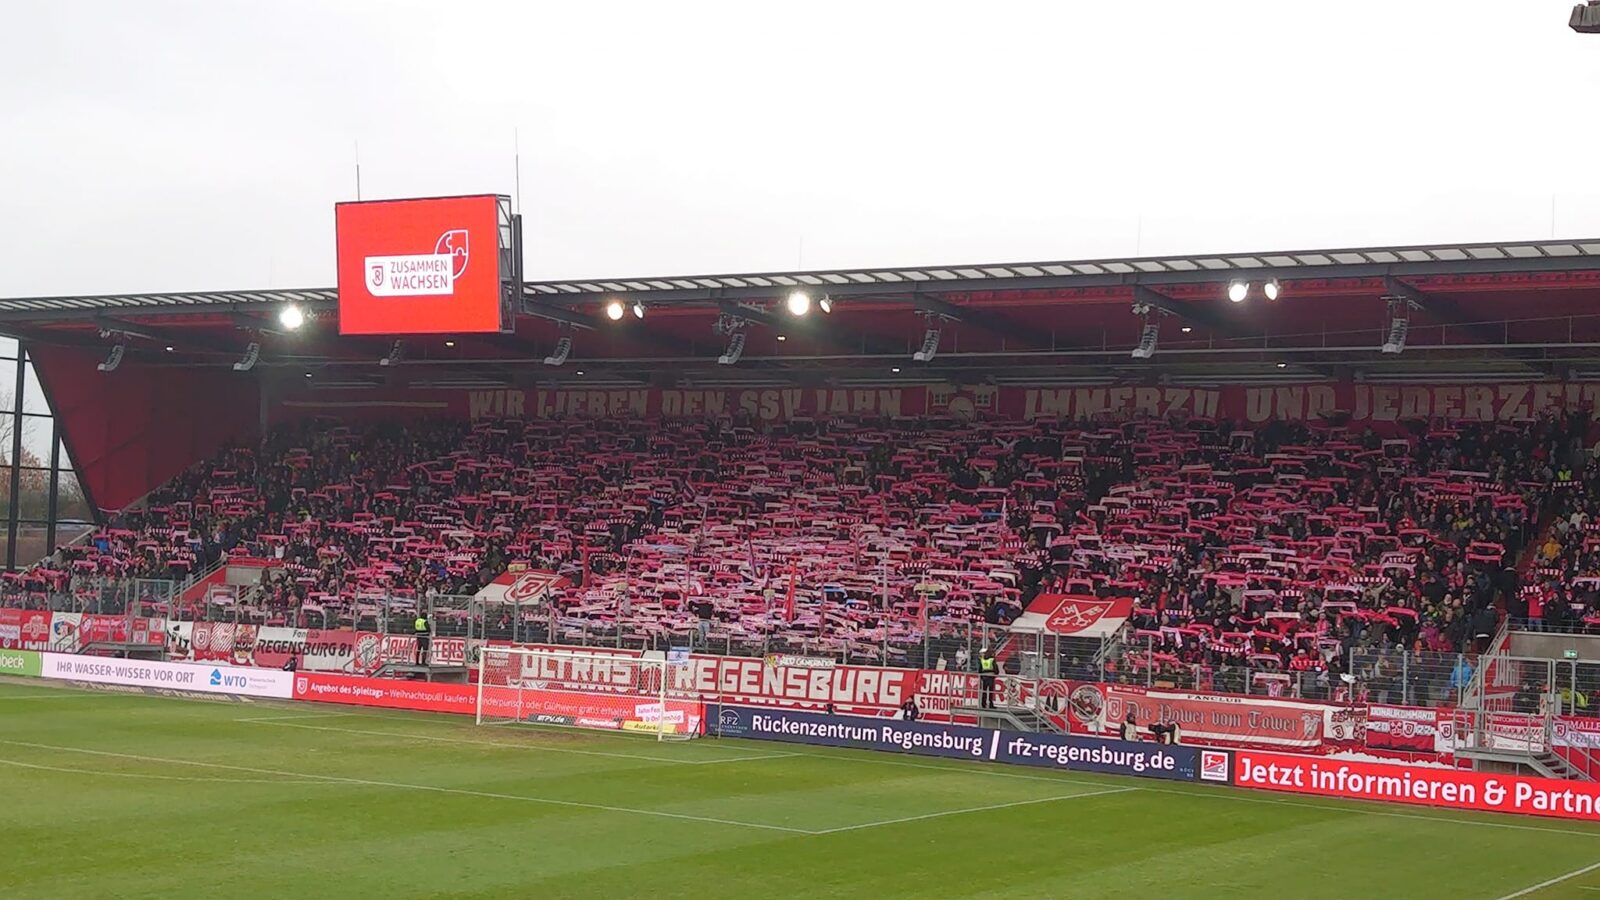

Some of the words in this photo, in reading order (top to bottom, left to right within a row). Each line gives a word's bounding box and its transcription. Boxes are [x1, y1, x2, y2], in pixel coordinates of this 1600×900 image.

[390, 259, 448, 273] ZUSAMMEN
[390, 275, 448, 290] WACHSEN
[468, 389, 526, 420] WIR
[740, 389, 803, 420] SSV
[1246, 386, 1336, 422] UND
[257, 639, 337, 658] REGENSBURG
[337, 642, 354, 657] 81
[0, 653, 25, 669] beck
[56, 661, 73, 673] IHR
[74, 662, 151, 680] WASSER-WISSER
[154, 669, 174, 682] VOR
[175, 671, 195, 683] ORT
[224, 675, 247, 688] WTO
[521, 649, 632, 685] ULTRAS
[675, 659, 904, 705] REGENSBURG
[920, 673, 965, 696] JAHN
[311, 682, 339, 695] Angebot
[339, 684, 352, 695] des
[352, 685, 384, 698] Spieltags
[389, 689, 443, 702] Weihnachtspulli
[444, 694, 468, 704] kaufen
[526, 701, 542, 710] oder
[1187, 694, 1242, 704] FANCLUB
[720, 715, 739, 726] RFZ
[1158, 703, 1205, 726] Power
[1211, 712, 1242, 728] vom
[1247, 710, 1299, 732] Tower
[752, 714, 877, 742] Rückenzentrum
[882, 726, 984, 756] Regensburg
[1007, 738, 1176, 772] rfz-regensburg.de
[1239, 757, 1304, 787] Jetzt
[1310, 763, 1475, 804] informieren
[1483, 779, 1508, 806] &
